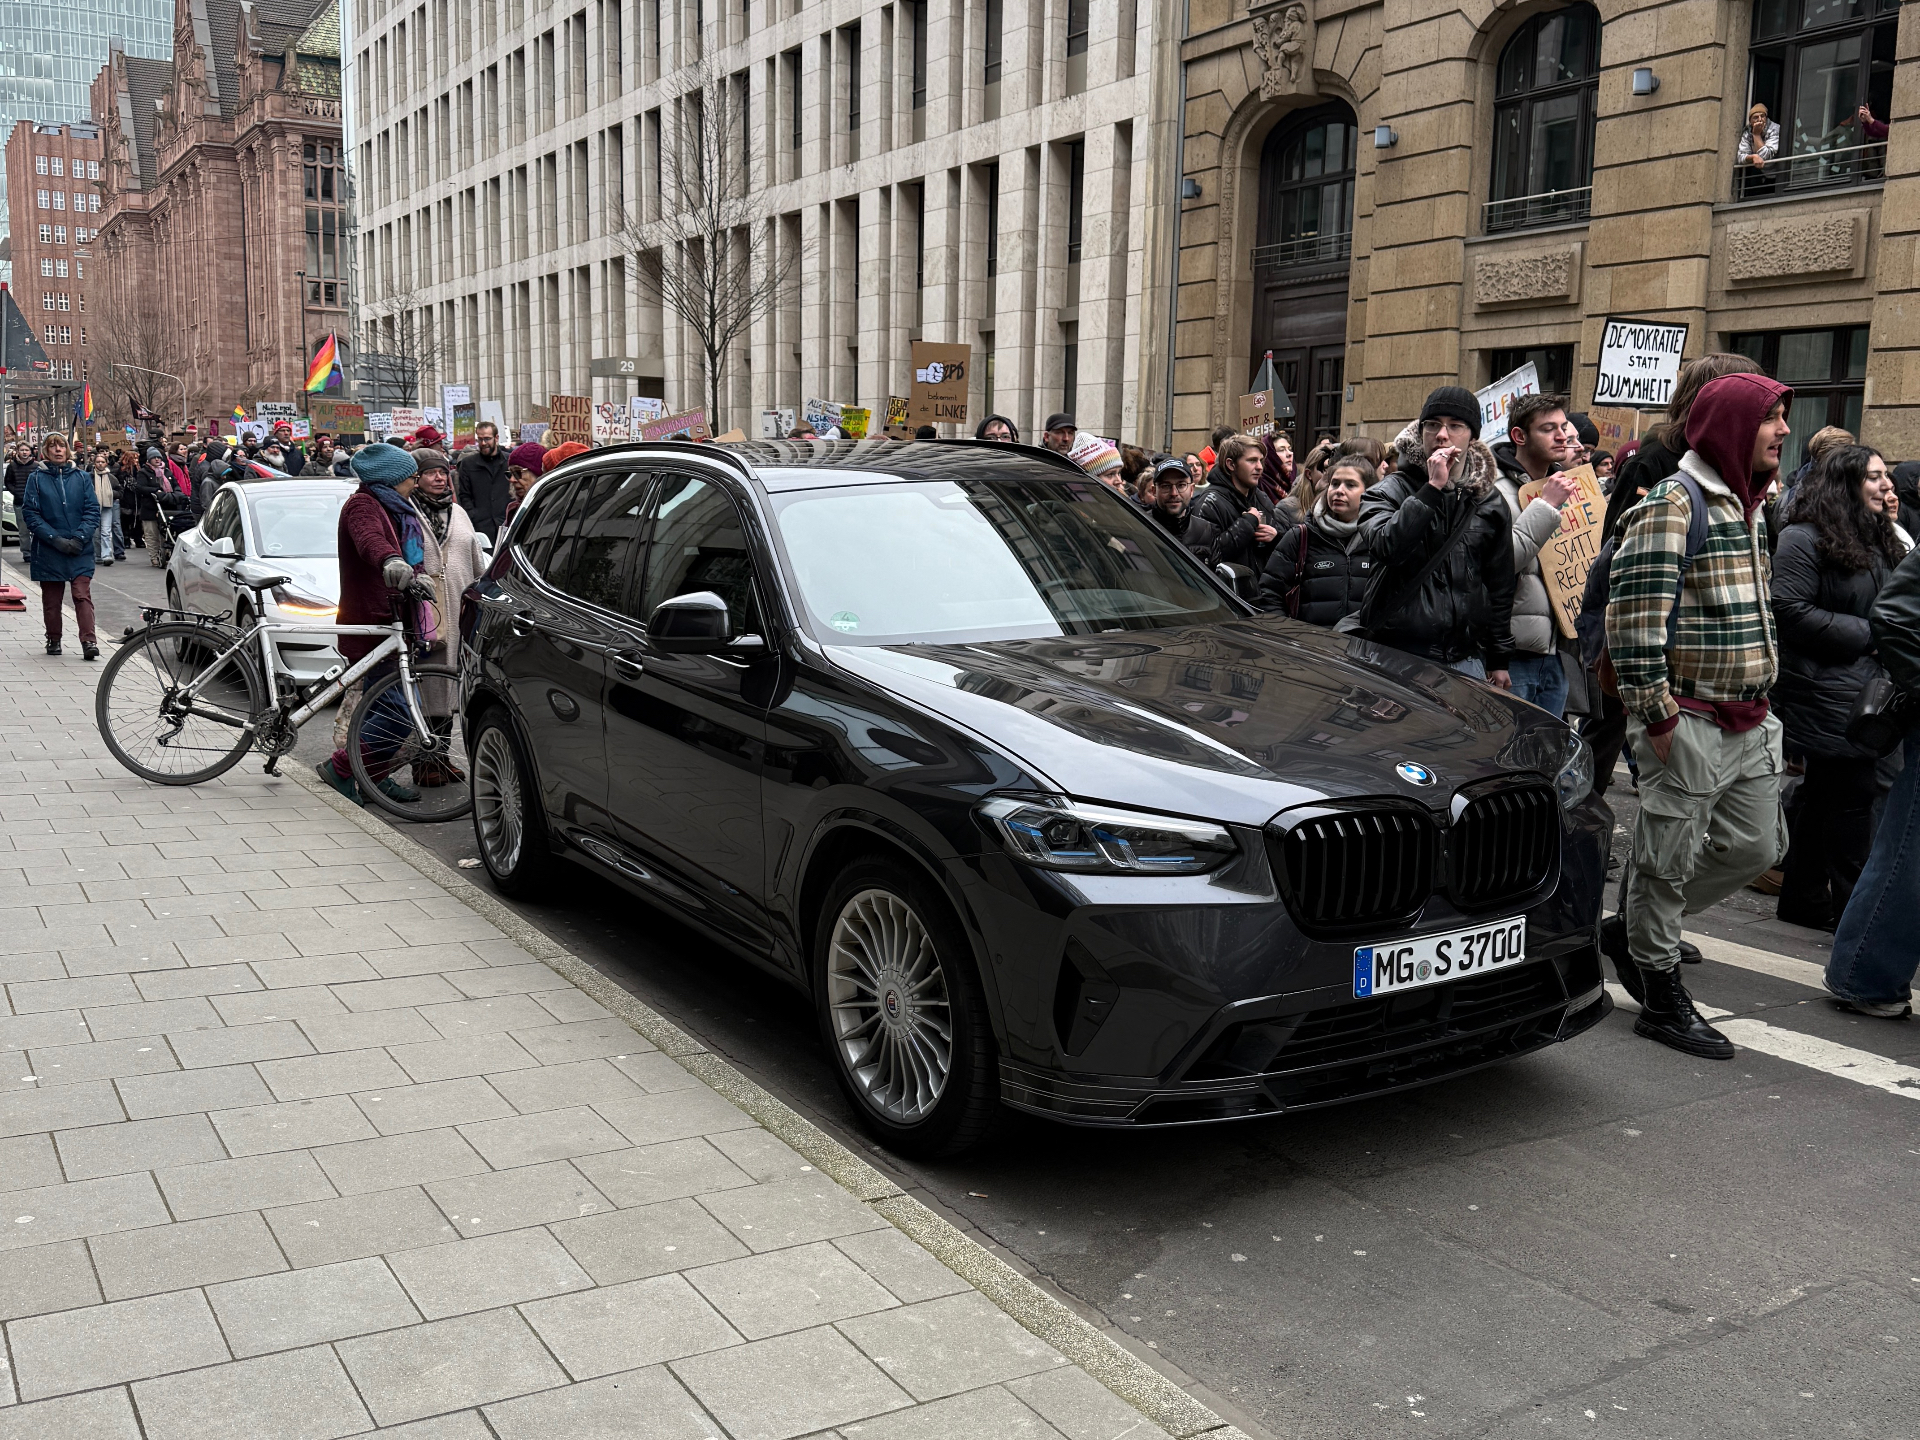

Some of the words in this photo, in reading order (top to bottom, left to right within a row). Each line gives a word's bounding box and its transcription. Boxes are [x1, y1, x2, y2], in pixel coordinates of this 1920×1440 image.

[1607, 325, 1684, 354] DEMOKRATIE
[620, 361, 635, 372] 29
[1628, 355, 1660, 370] STATT
[1598, 373, 1671, 402] DUMMHEIT
[891, 399, 908, 408] KEIN
[927, 391, 957, 401] bekommt
[552, 395, 591, 414] RECHTS
[889, 407, 907, 417] ORT
[935, 404, 967, 419] LINKE!
[552, 415, 590, 431] ZEITIG
[1242, 415, 1259, 427] ROT
[1246, 422, 1274, 437] WEISS
[1554, 530, 1595, 566] STATT
[1562, 592, 1584, 624] MEN
[1375, 947, 1414, 988] MG
[1434, 940, 1452, 976] S
[1458, 924, 1522, 971] 3700
[1360, 977, 1368, 988] D
